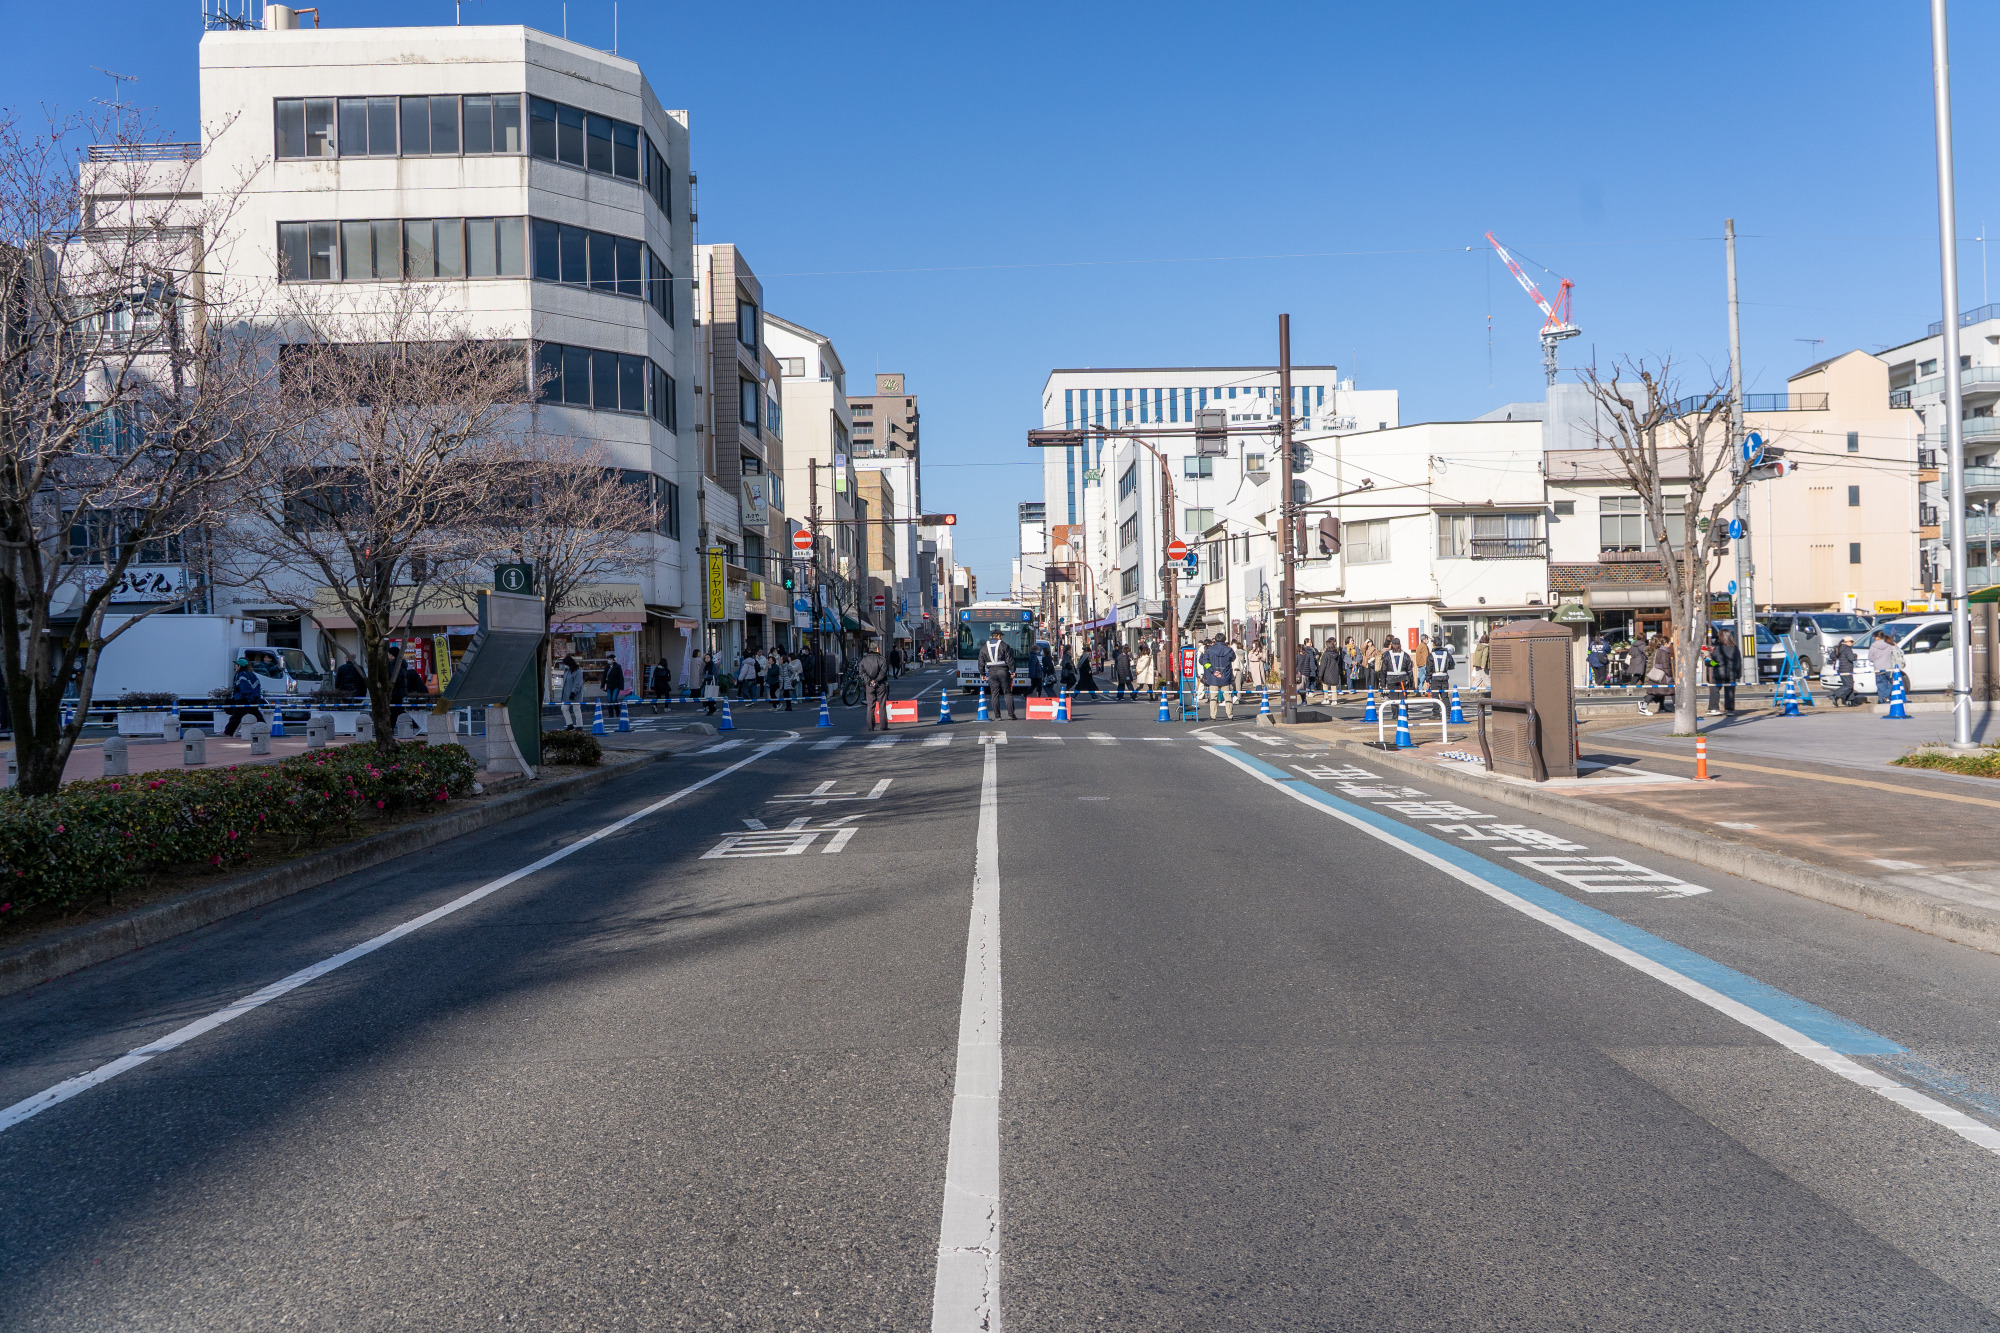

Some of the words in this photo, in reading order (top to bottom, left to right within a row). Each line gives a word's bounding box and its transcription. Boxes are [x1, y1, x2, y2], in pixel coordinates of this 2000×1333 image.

[711, 551, 723, 614] キムラヤのパン
[567, 597, 635, 607] KIMURAYA
[1879, 605, 1899, 613] Times
[1184, 651, 1193, 675] 解除中
